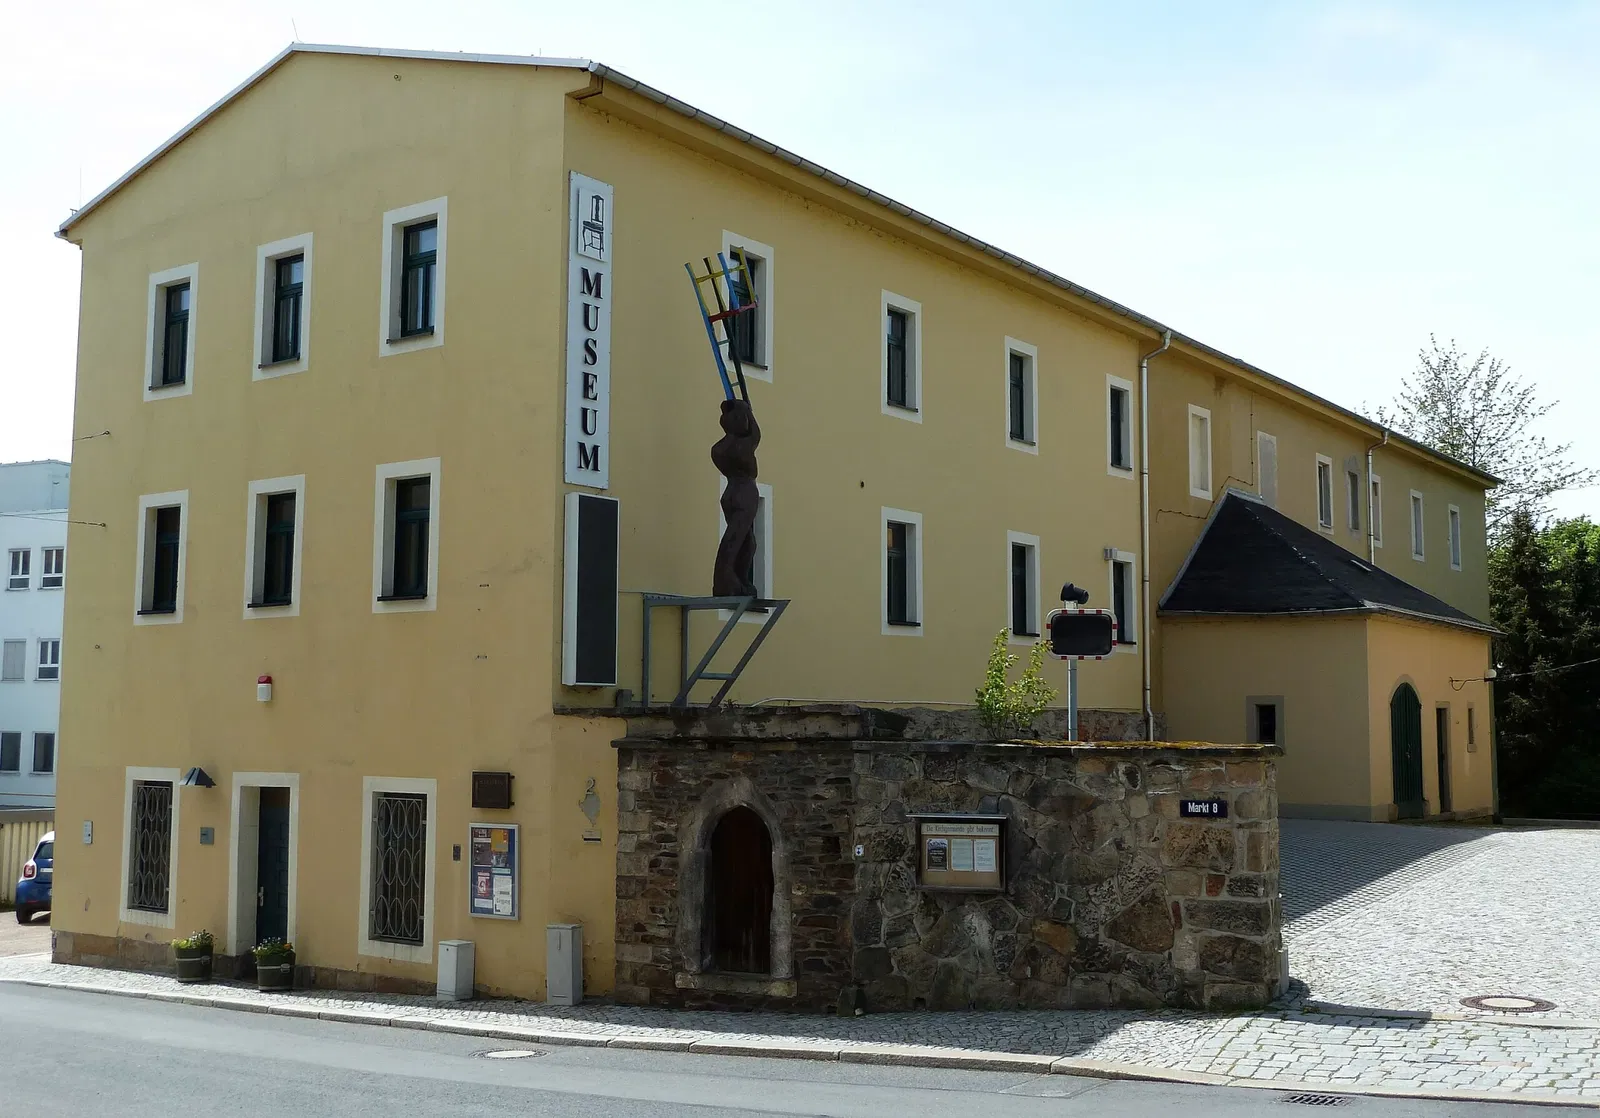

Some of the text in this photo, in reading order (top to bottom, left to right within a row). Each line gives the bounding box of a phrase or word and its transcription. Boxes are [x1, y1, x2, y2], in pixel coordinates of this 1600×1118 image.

[577, 266, 603, 472] MUSEUM
[1188, 802, 1218, 813] Markt 8
